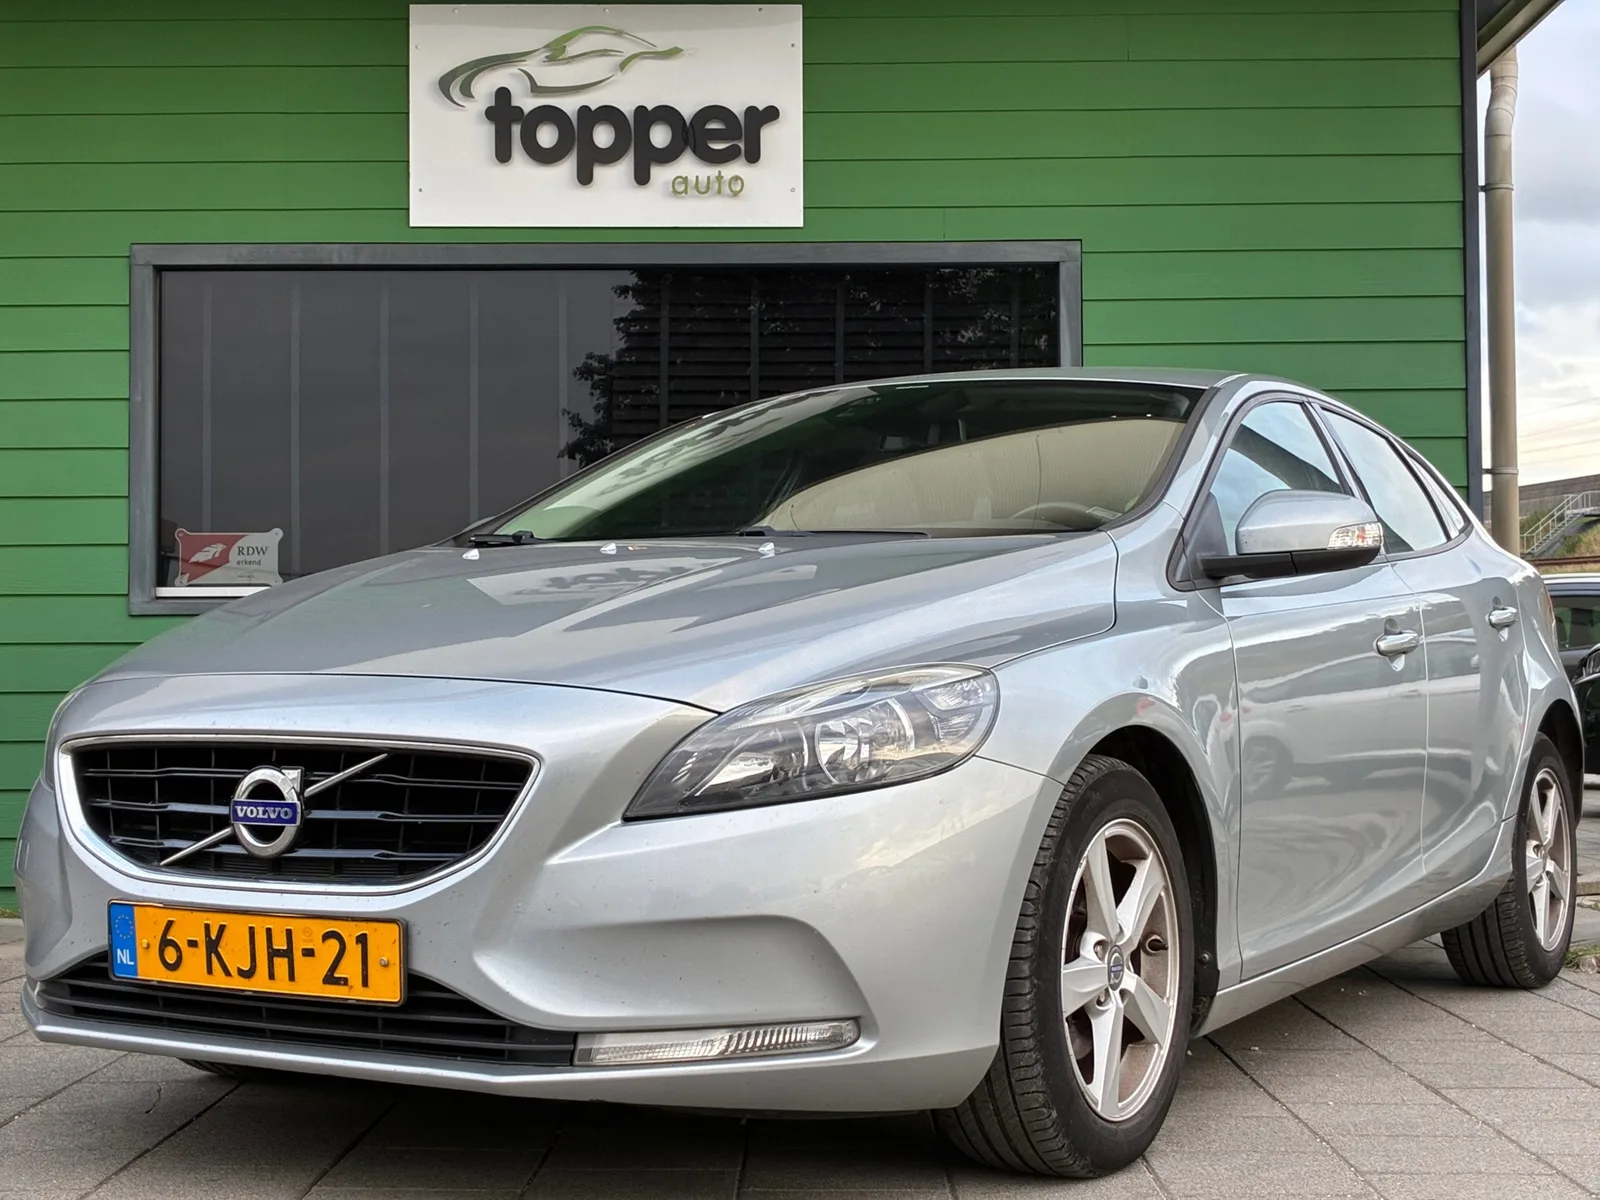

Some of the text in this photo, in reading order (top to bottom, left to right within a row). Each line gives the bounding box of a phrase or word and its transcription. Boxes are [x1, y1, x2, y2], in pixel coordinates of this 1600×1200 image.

[485, 86, 780, 186] topper
[671, 170, 745, 197] auto
[237, 546, 268, 556] RDW
[235, 806, 293, 819] VOLVO
[117, 948, 135, 966] NL
[158, 918, 370, 988] 6-KJH-21
